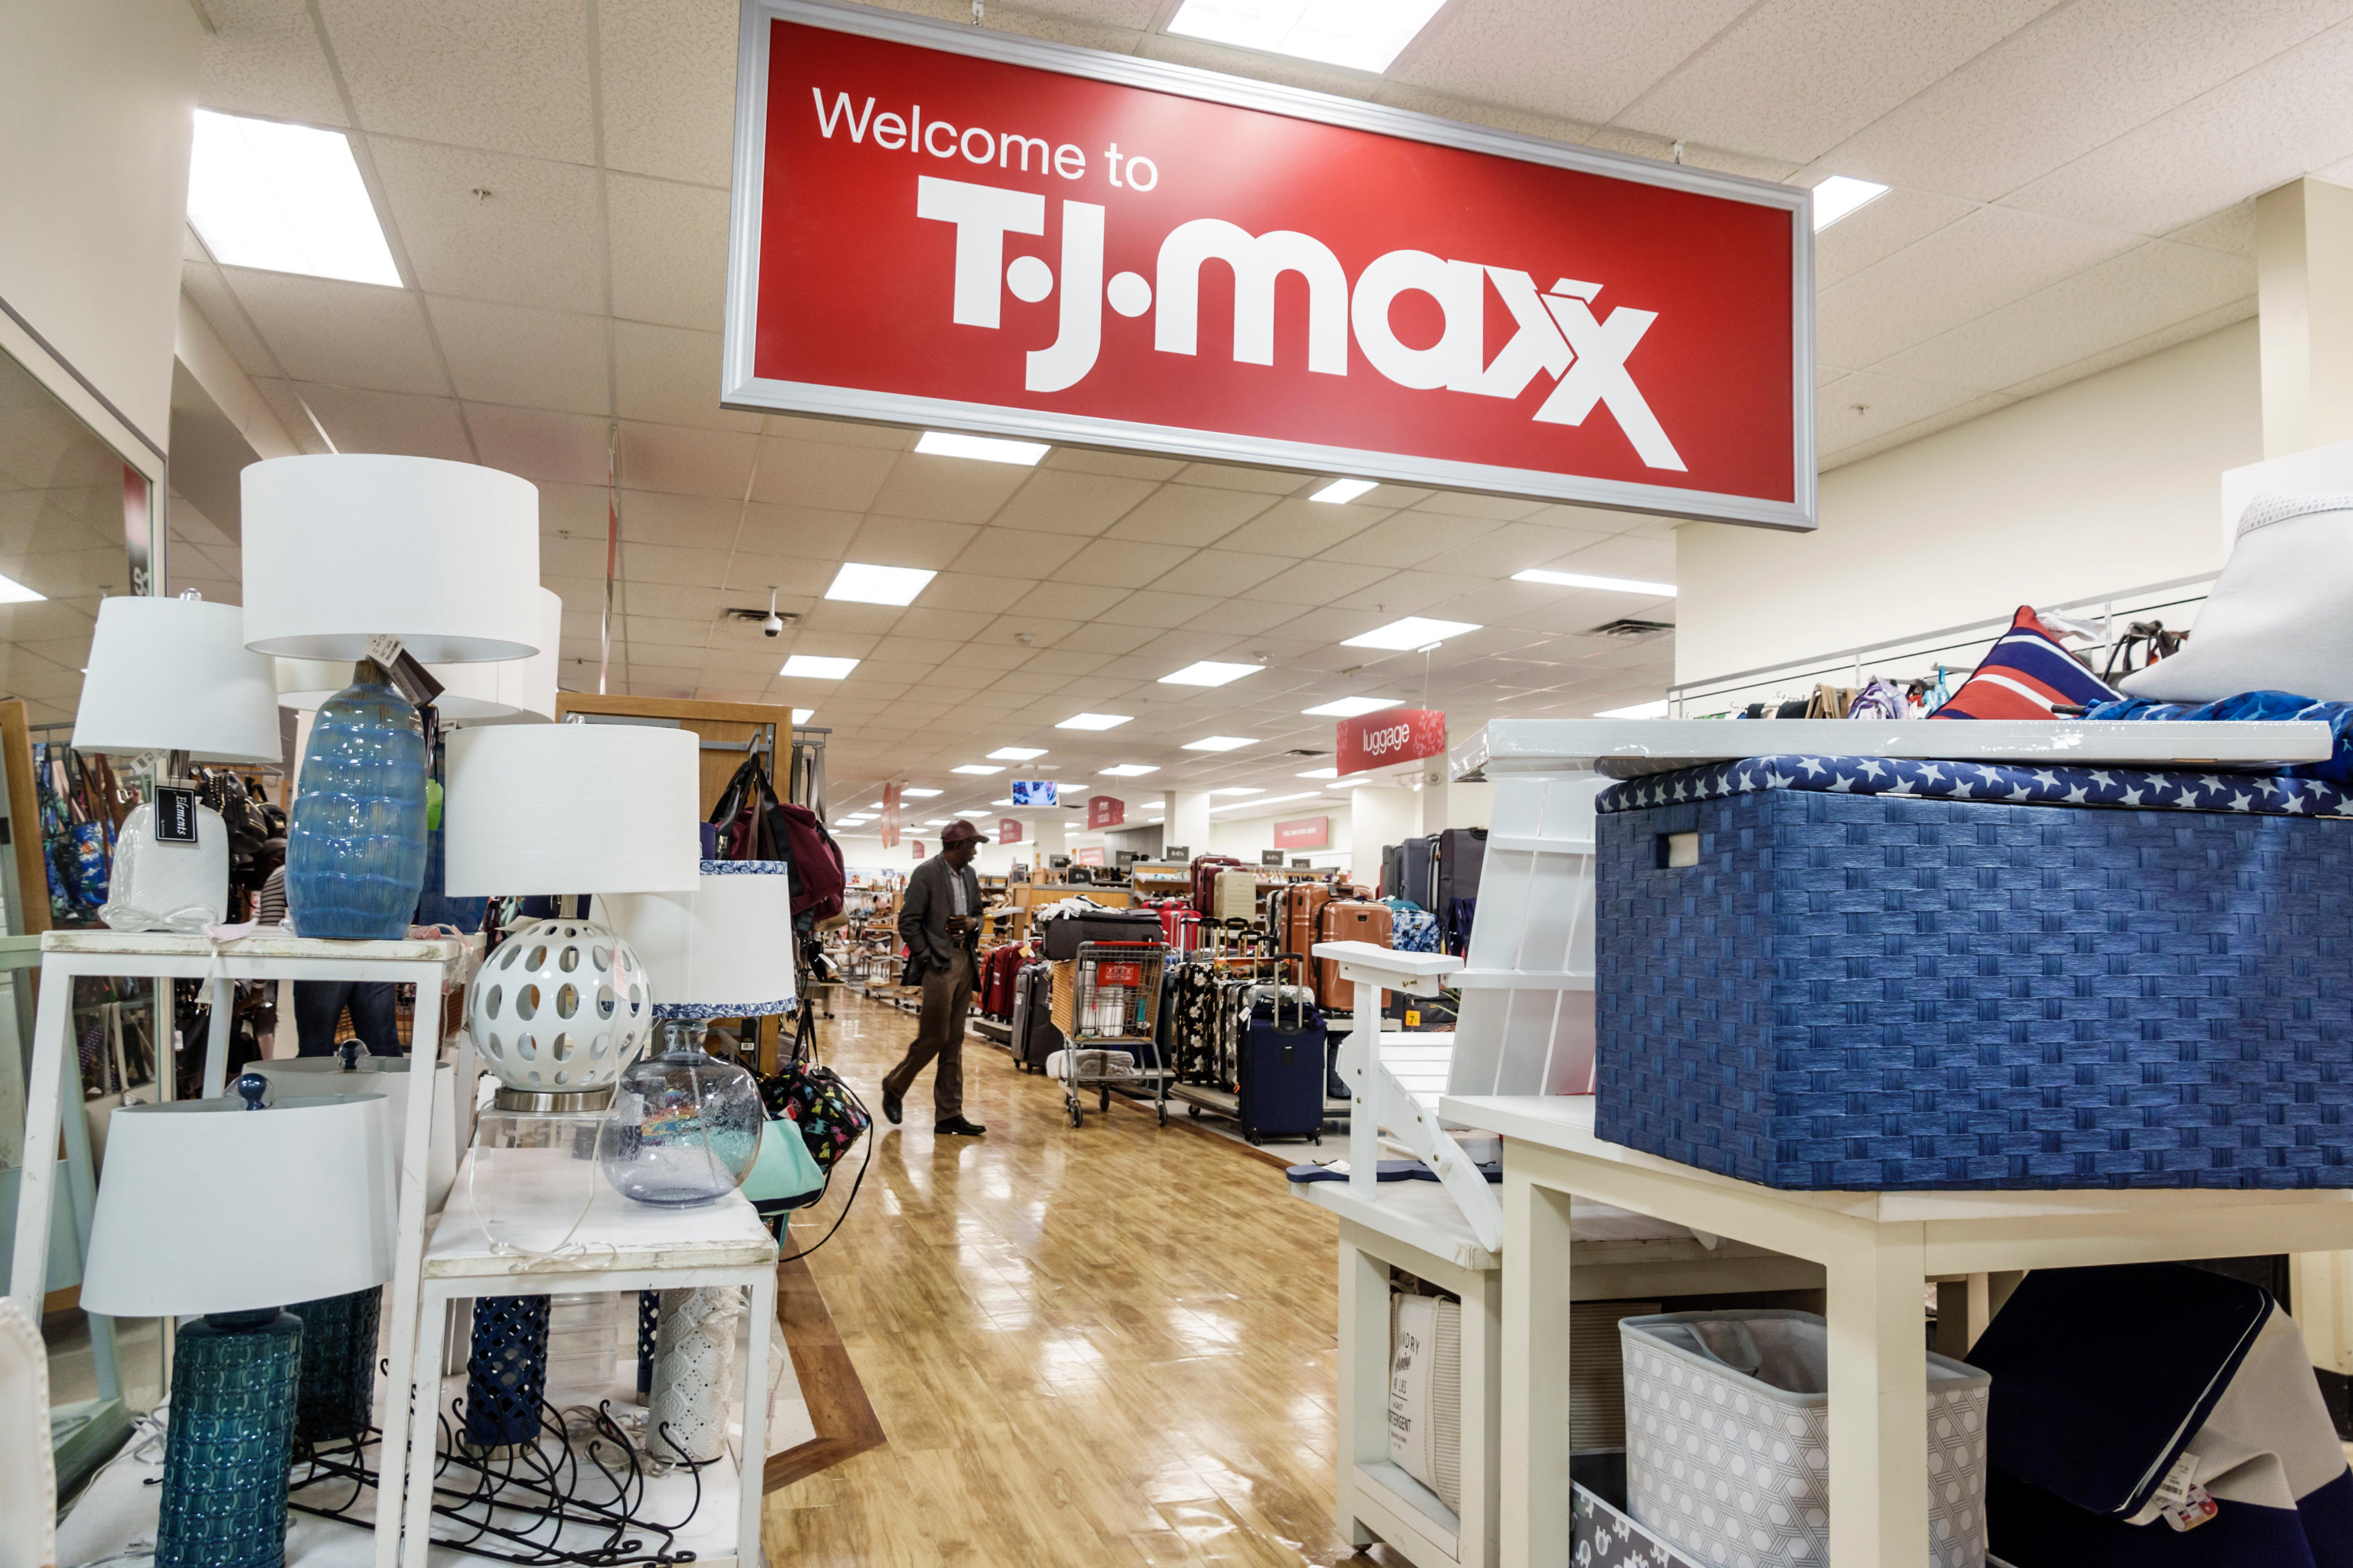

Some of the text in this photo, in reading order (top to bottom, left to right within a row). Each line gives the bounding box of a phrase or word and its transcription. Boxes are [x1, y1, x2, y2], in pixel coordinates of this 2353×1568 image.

[812, 87, 1159, 192] Welcome to
[1363, 723, 1410, 756] luggage
[176, 795, 189, 836] Elements
